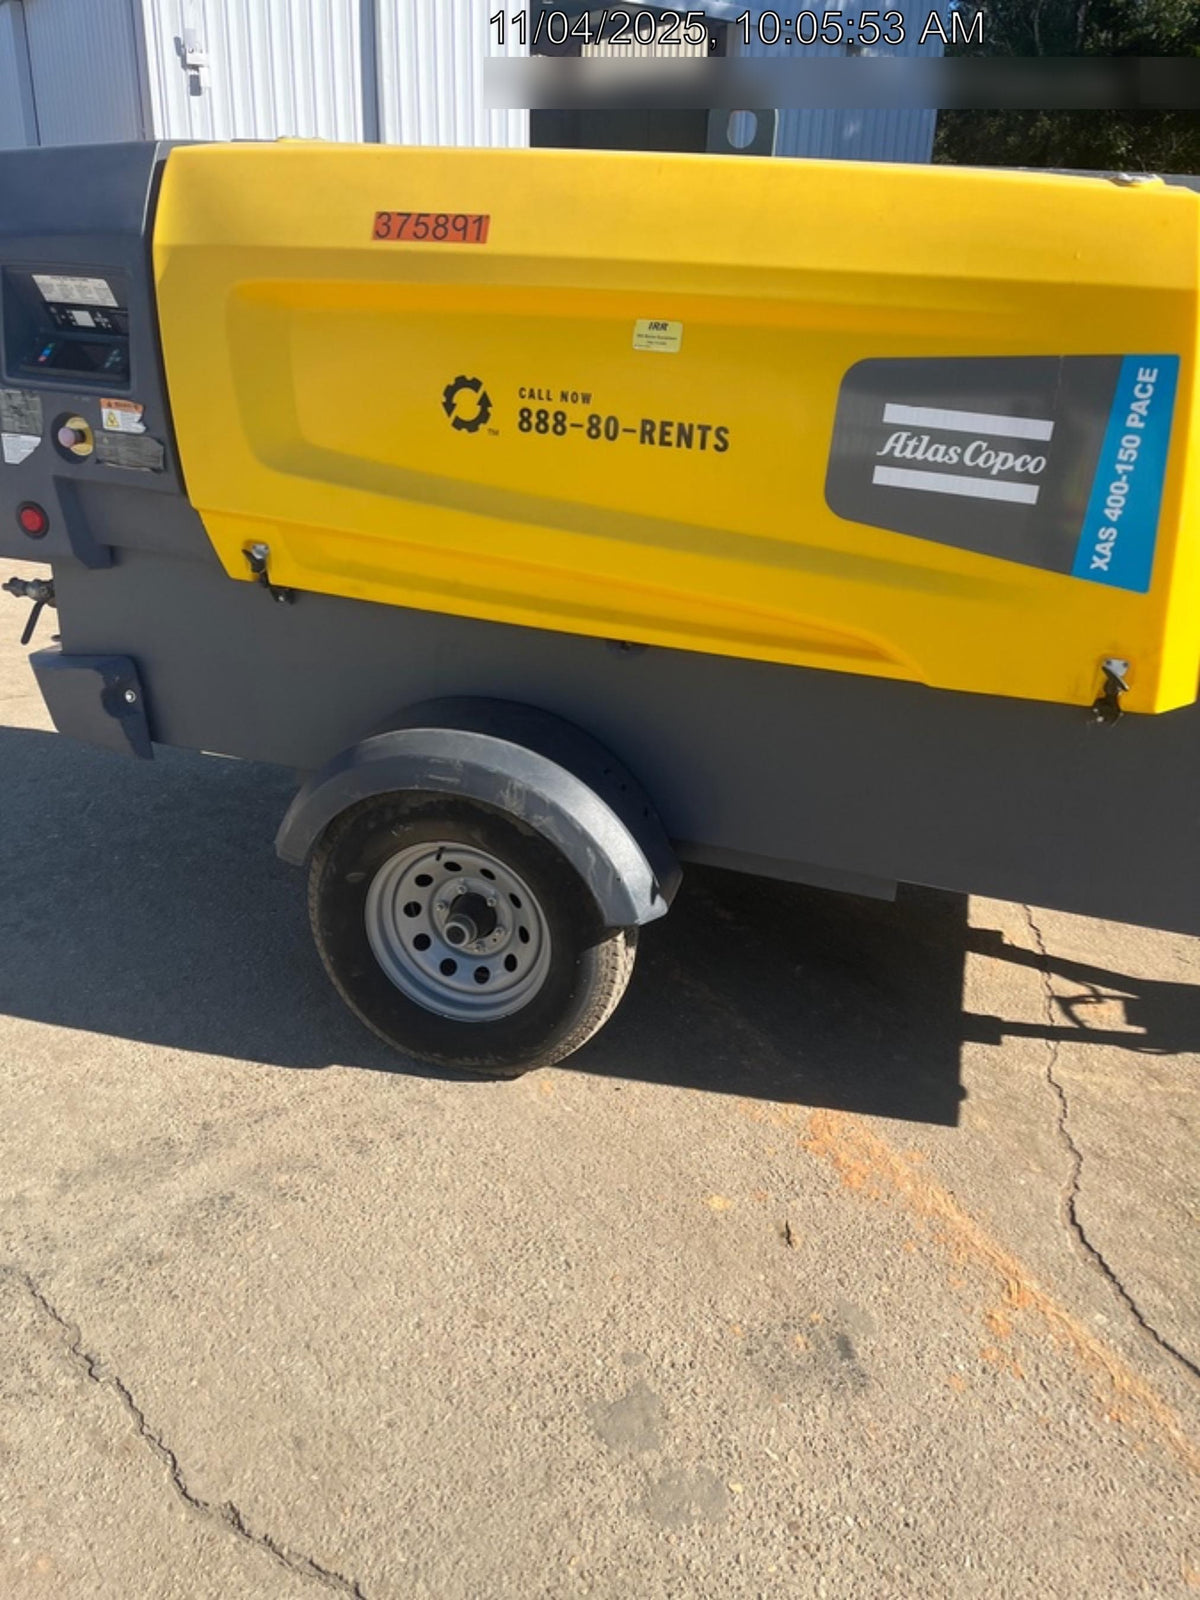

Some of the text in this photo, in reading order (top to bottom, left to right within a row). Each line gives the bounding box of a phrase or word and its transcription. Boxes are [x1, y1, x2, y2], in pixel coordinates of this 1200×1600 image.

[375, 211, 484, 242] 375891
[519, 387, 592, 404] CALL NOW
[518, 407, 730, 453] 888-80-RENTS
[876, 431, 1046, 475] Atlas Copco
[1090, 367, 1158, 571] XAS 400-150 PACE
